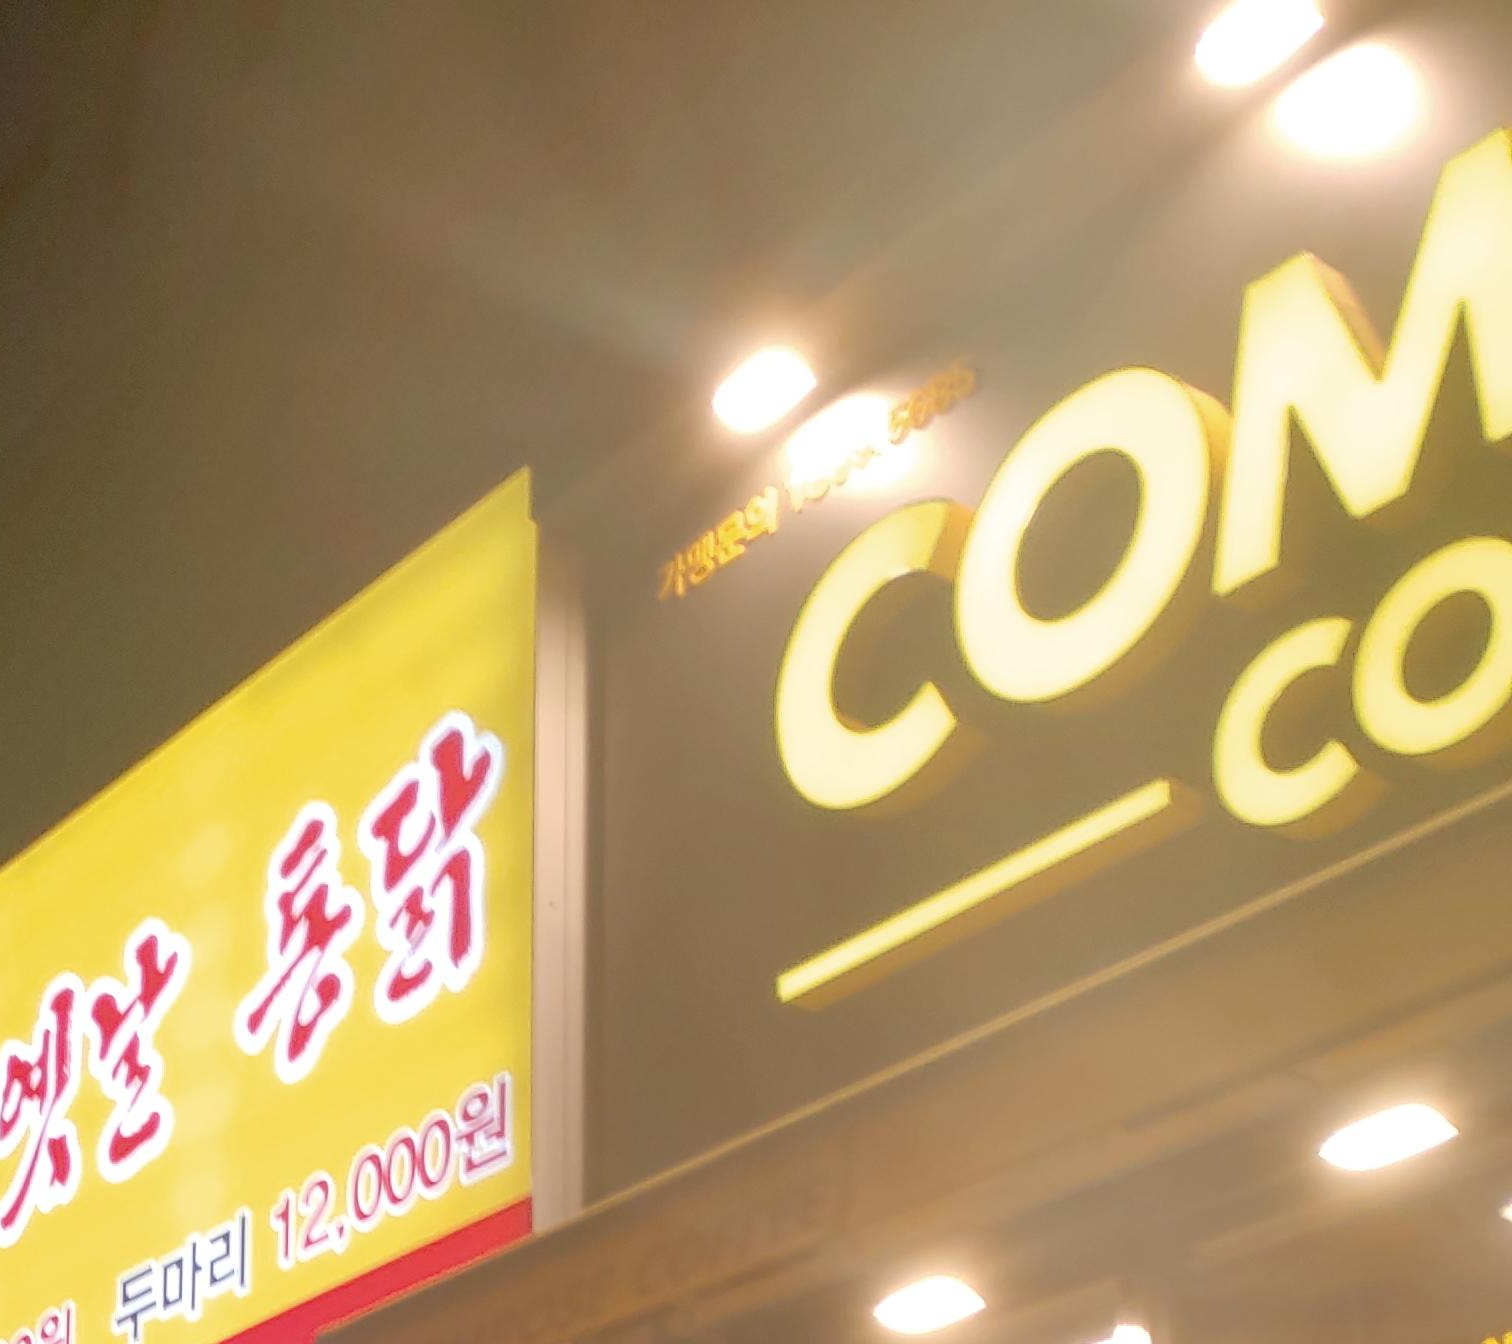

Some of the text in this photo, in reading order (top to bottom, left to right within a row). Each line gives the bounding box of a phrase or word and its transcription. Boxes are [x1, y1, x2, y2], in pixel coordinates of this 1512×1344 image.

[774, 126, 1512, 810] COM
[246, 726, 492, 1064] 통닭
[115, 1212, 247, 1343] 두마리
[272, 1079, 509, 1262] 12,000원
